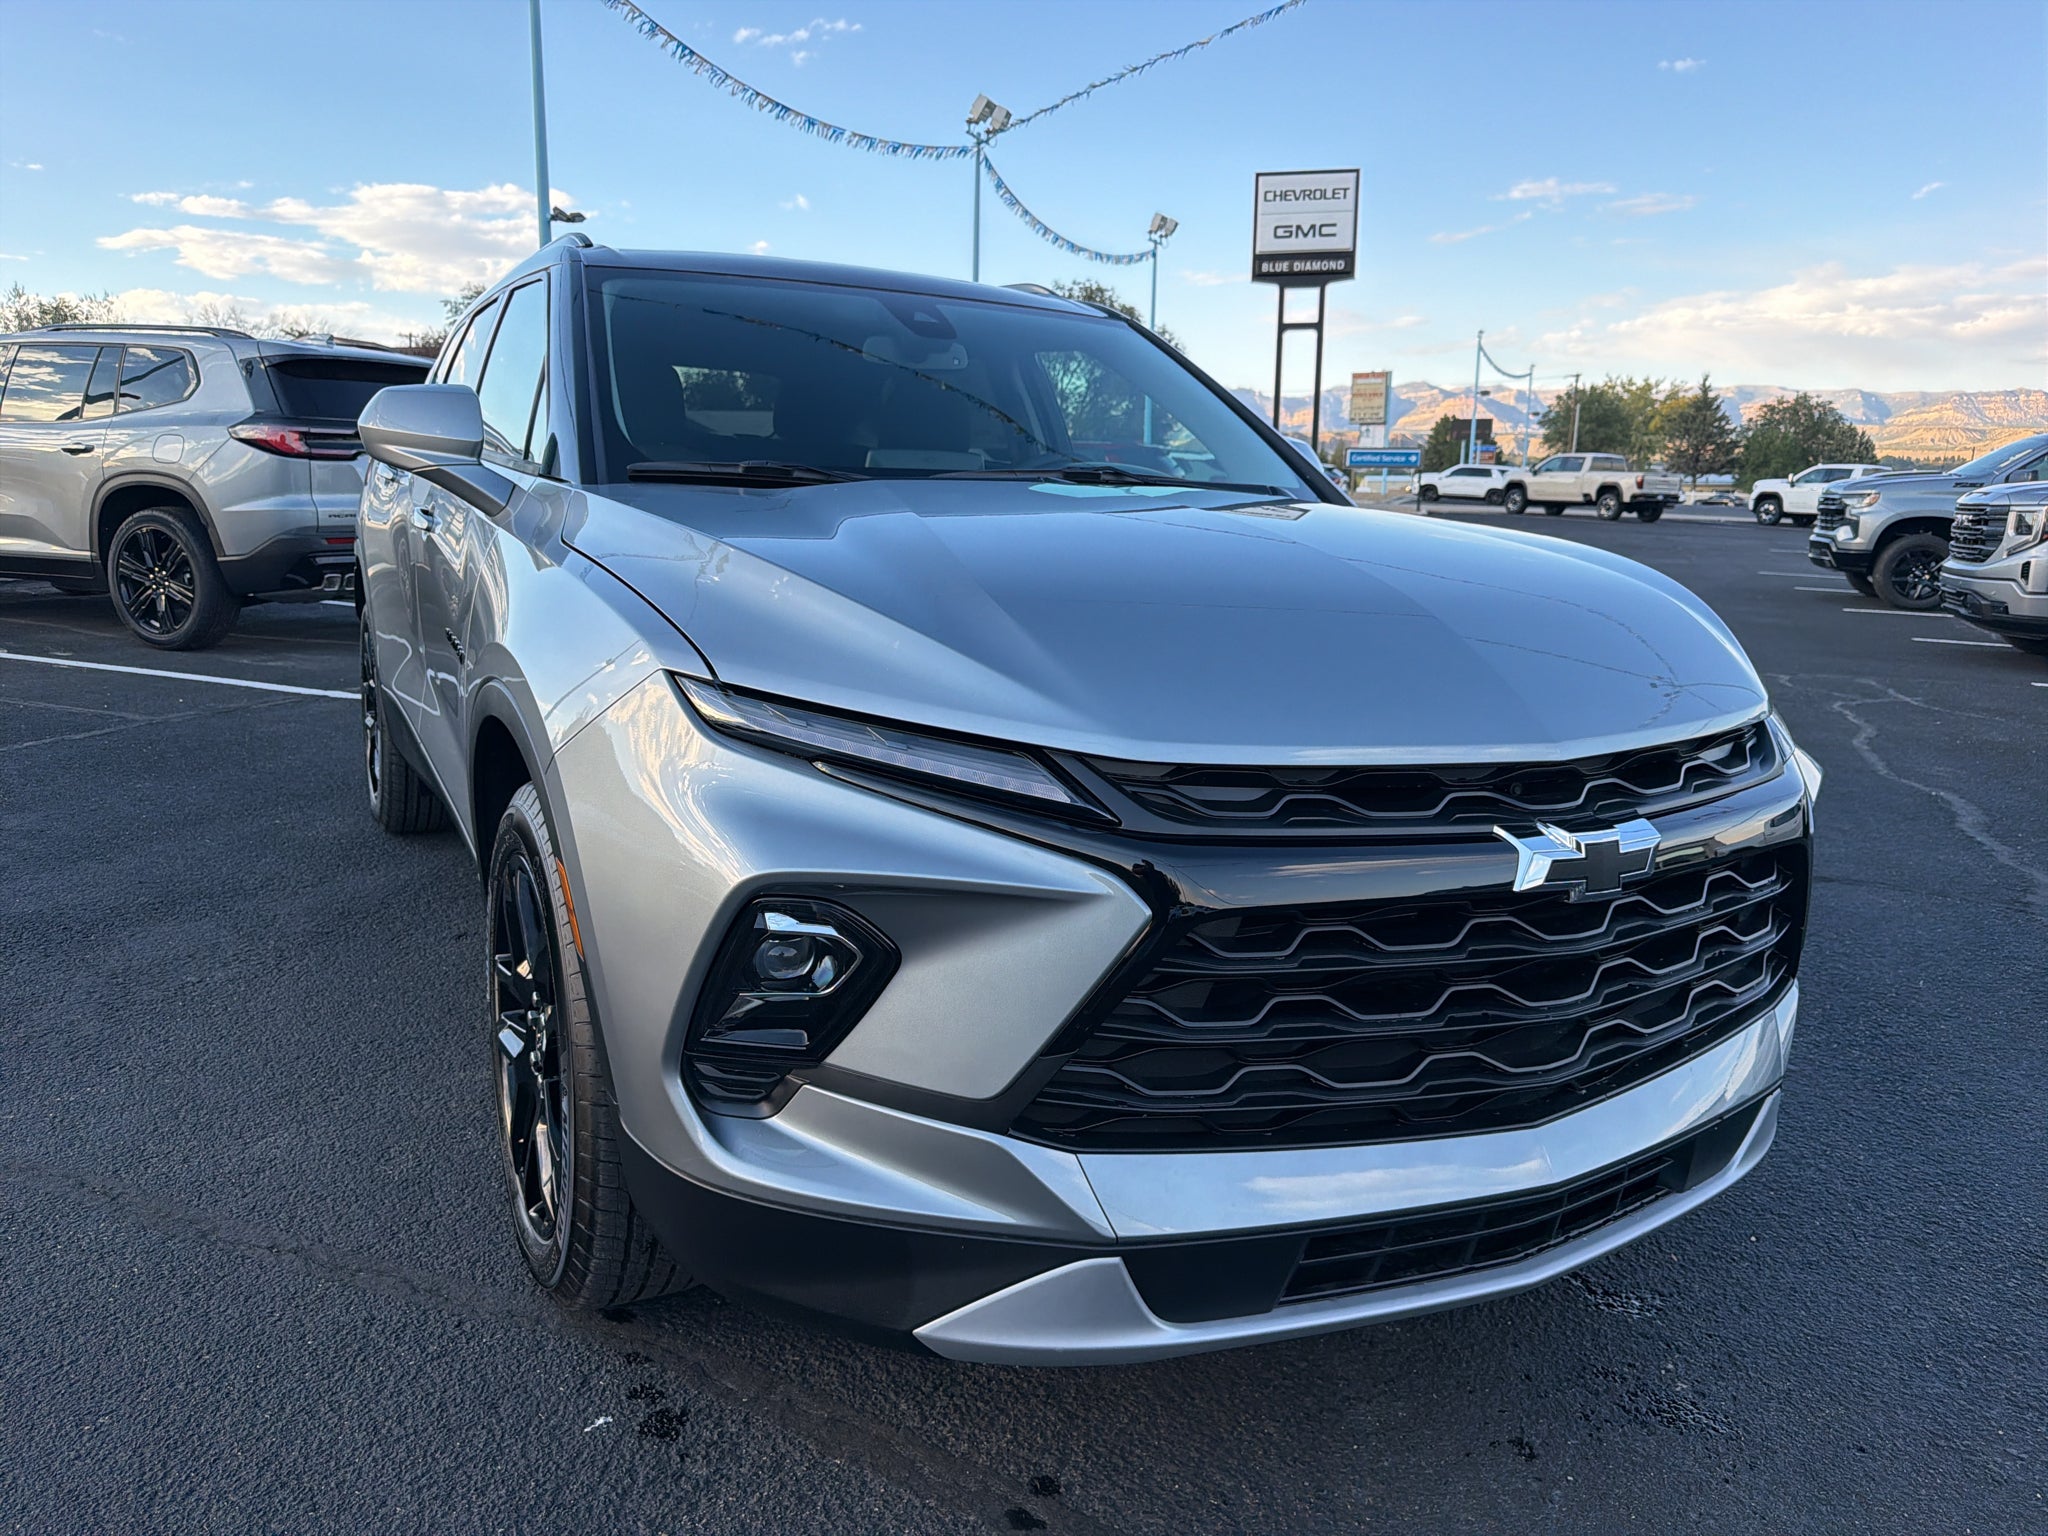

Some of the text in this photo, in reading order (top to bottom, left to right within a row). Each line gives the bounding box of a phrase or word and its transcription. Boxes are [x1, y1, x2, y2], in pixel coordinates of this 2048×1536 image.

[1263, 187, 1350, 202] CHEVROLET
[1273, 223, 1337, 239] GMC
[1261, 260, 1345, 272] BLUE DIAMOND
[1382, 455, 1406, 463] Service
